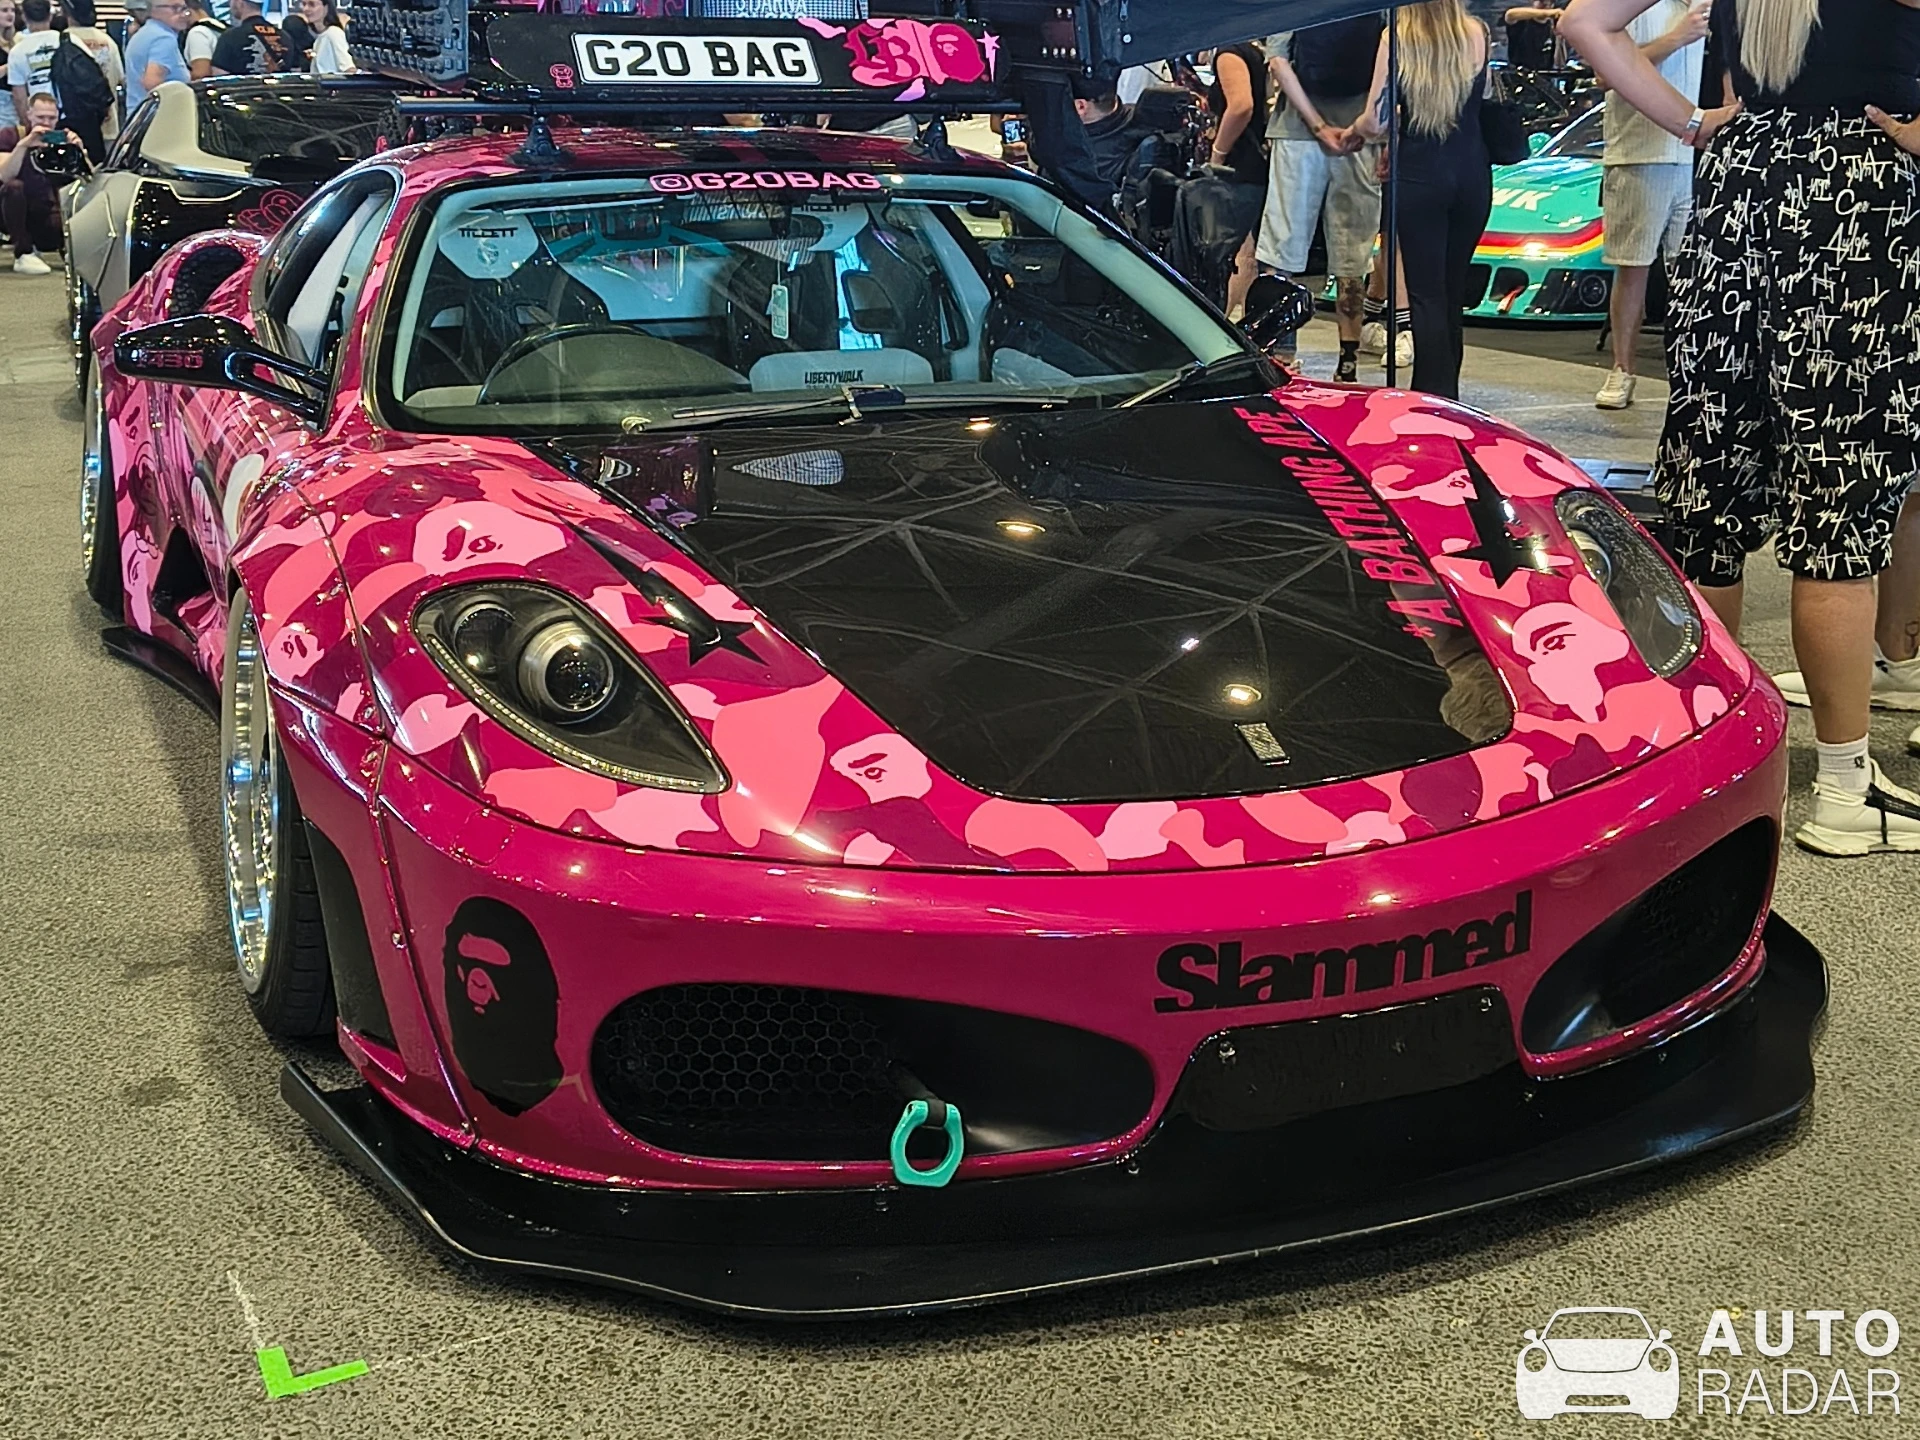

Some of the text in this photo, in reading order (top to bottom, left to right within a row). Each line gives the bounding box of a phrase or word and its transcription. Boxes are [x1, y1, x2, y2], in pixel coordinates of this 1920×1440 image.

[585, 39, 807, 77] G20 BAG
[692, 171, 882, 190] G20BAG
[1233, 407, 1328, 451] APE
[1280, 456, 1436, 585] BATHING
[1154, 889, 1533, 1014] Slammed
